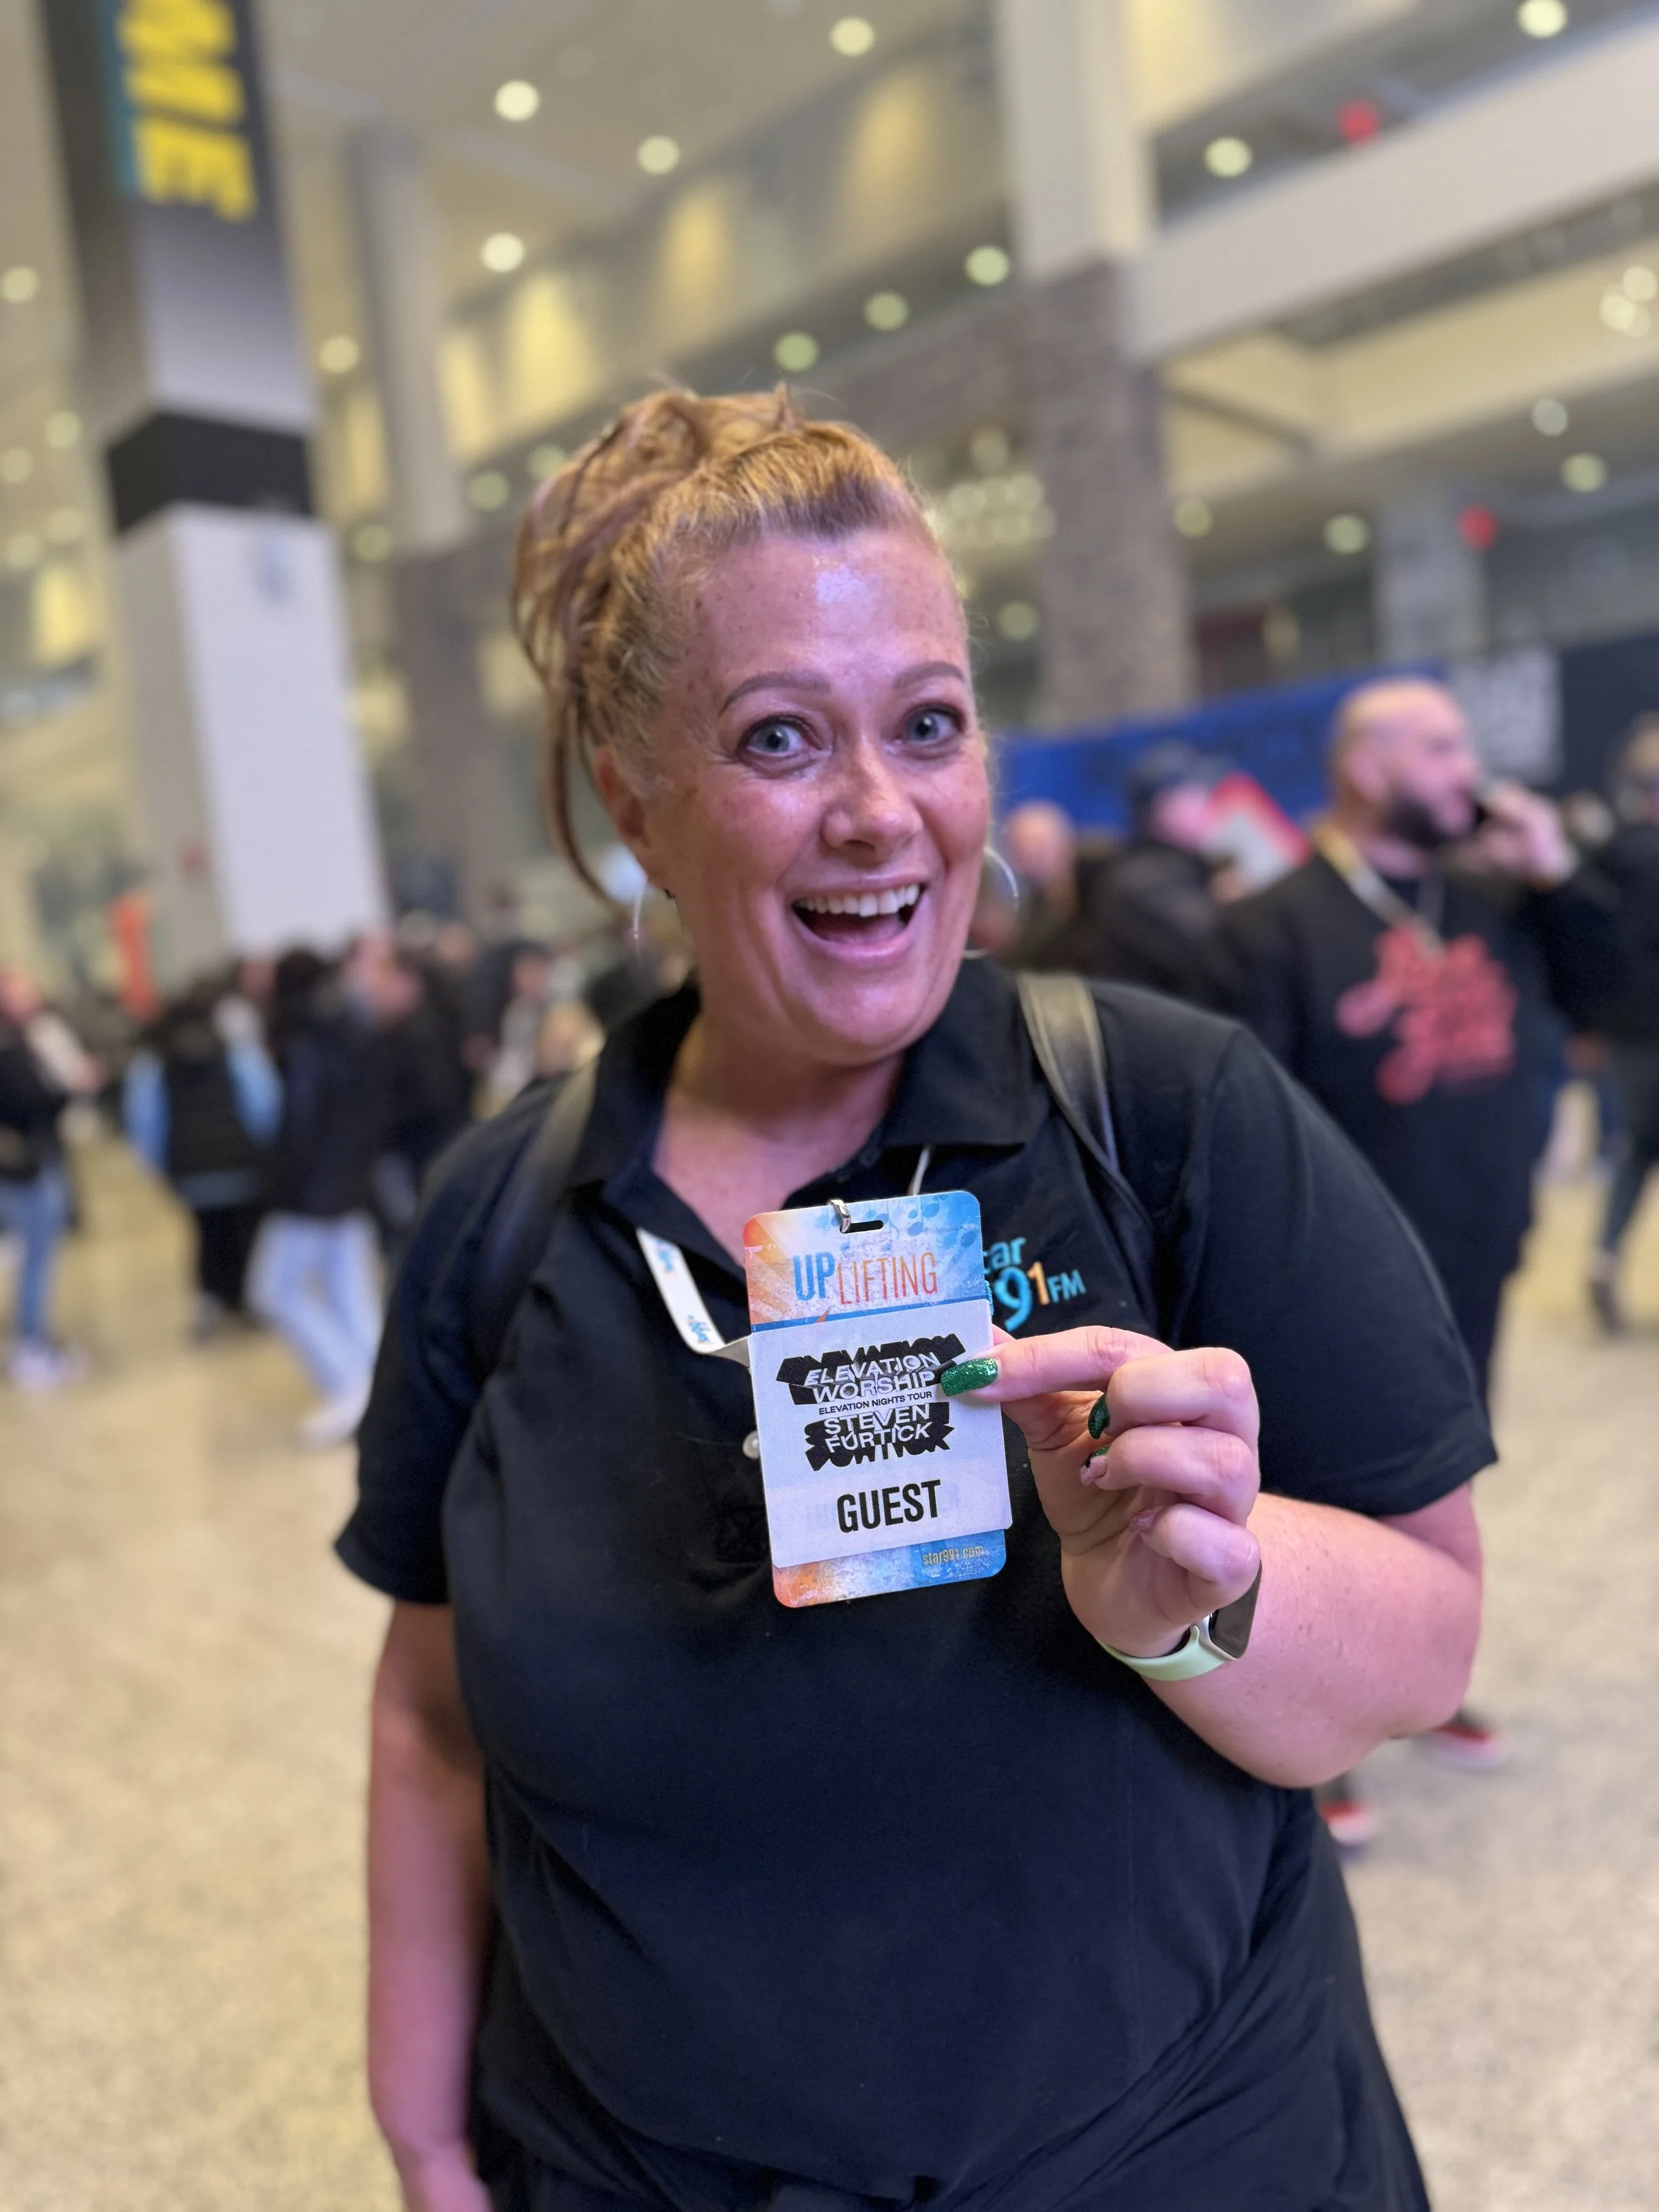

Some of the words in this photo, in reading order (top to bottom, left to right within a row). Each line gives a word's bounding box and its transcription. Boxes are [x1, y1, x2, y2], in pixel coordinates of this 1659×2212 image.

[983, 1237, 1026, 1274] ar
[793, 1252, 938, 1305] UPLIFTING
[804, 1352, 941, 1386] ELEVATION
[813, 1370, 935, 1404] WORSHIP
[819, 1401, 869, 1415] ELEVATION
[871, 1395, 906, 1408] NIGHTS
[907, 1391, 932, 1401] TOUR
[824, 1403, 930, 1435] STEVEN
[825, 1422, 932, 1453] FURTICK
[837, 1479, 941, 1533] GUEST
